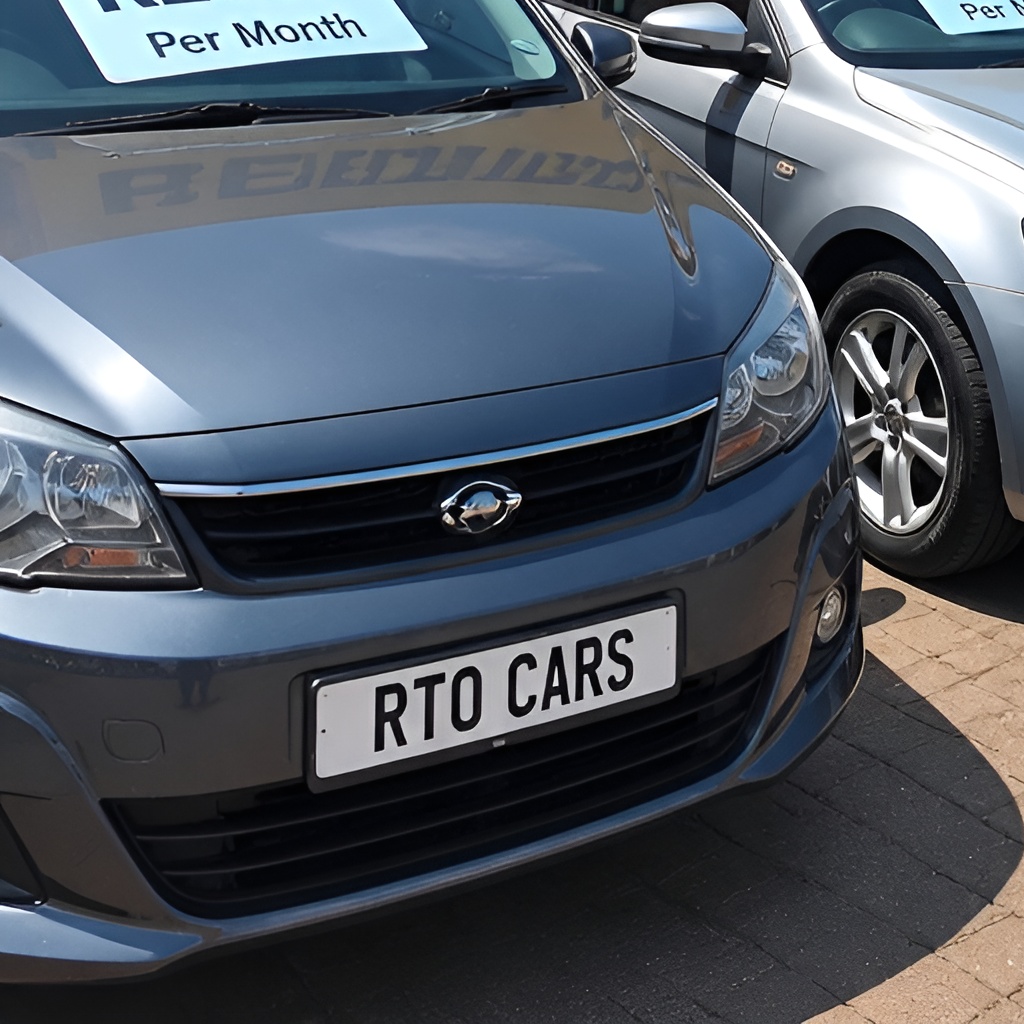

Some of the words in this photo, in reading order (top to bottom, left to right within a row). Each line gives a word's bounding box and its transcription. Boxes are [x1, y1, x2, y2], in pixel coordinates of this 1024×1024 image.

[959, 1, 1004, 21] Per
[146, 29, 221, 59] Per
[232, 12, 368, 50] Month
[373, 665, 483, 753] RTO
[507, 628, 635, 718] CARS
